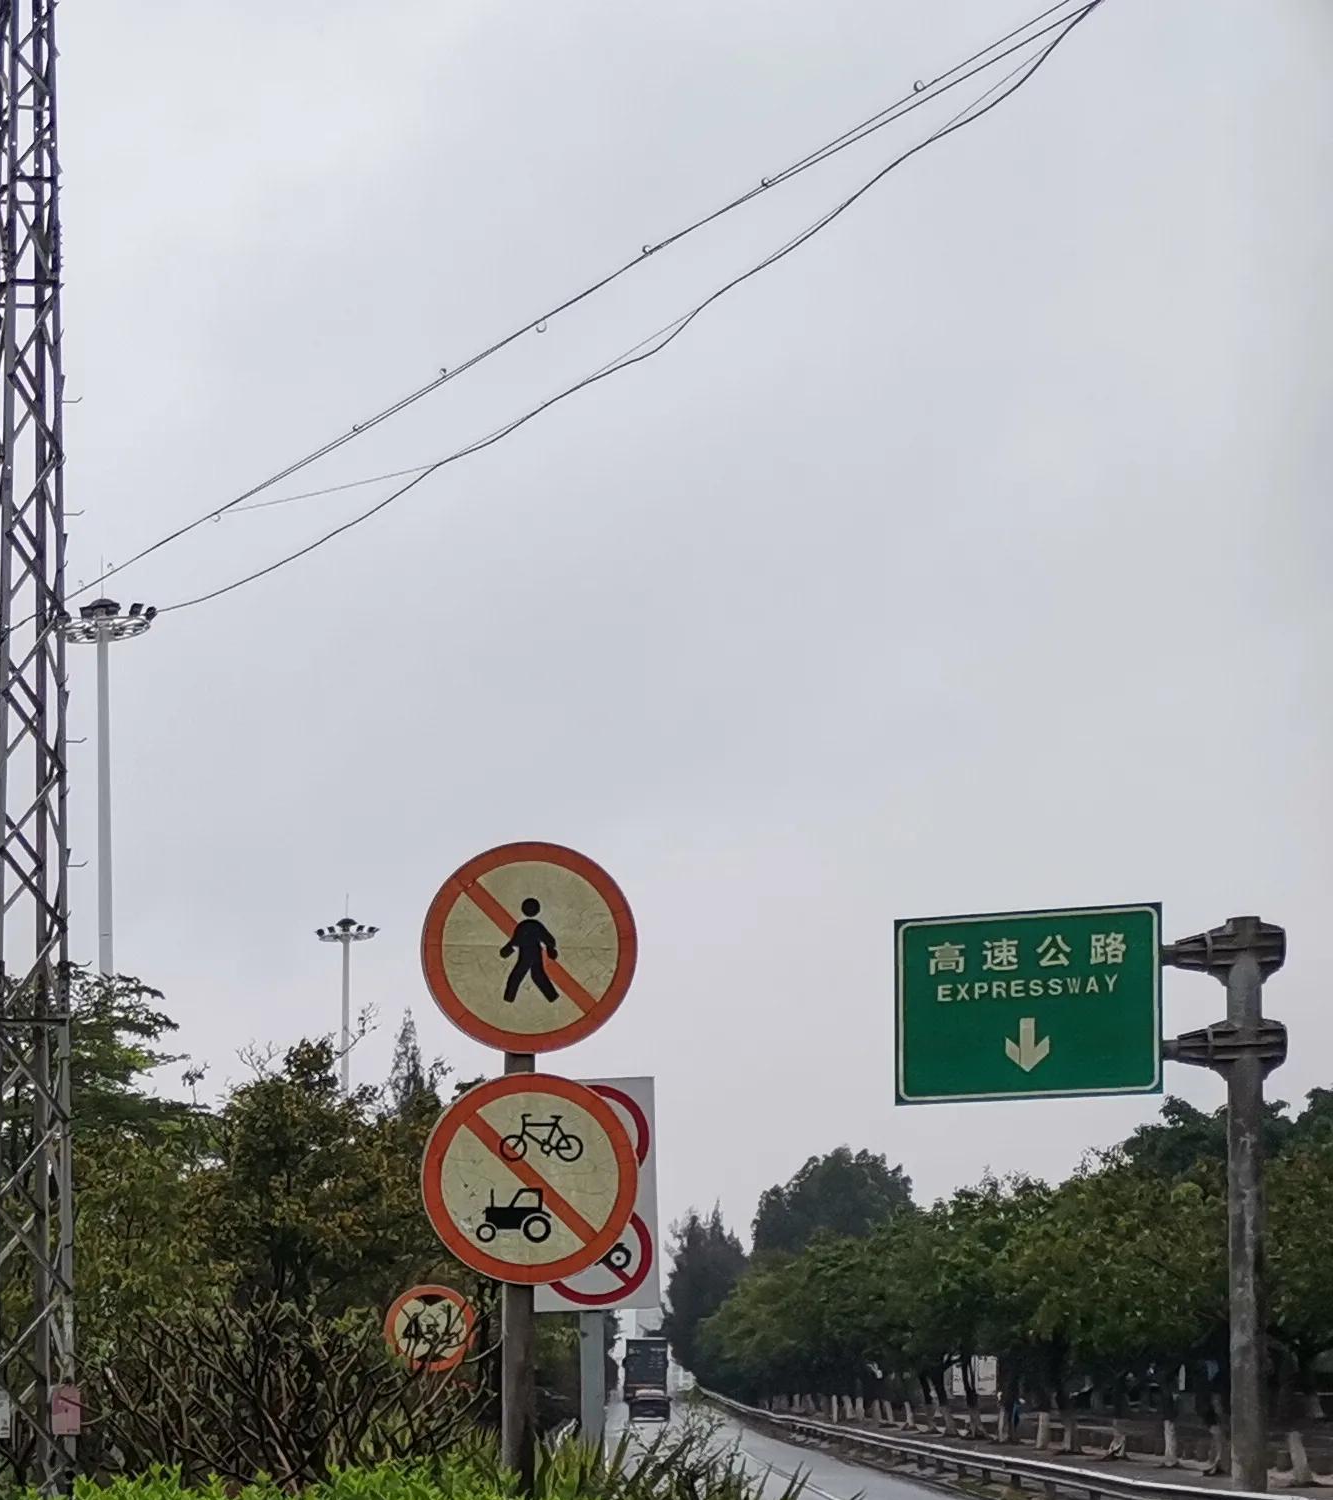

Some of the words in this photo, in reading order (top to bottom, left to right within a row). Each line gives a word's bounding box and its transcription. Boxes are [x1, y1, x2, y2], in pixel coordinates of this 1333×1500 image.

[927, 932, 1127, 976] 高速公路
[936, 973, 1119, 1003] EXPRESSWAY
